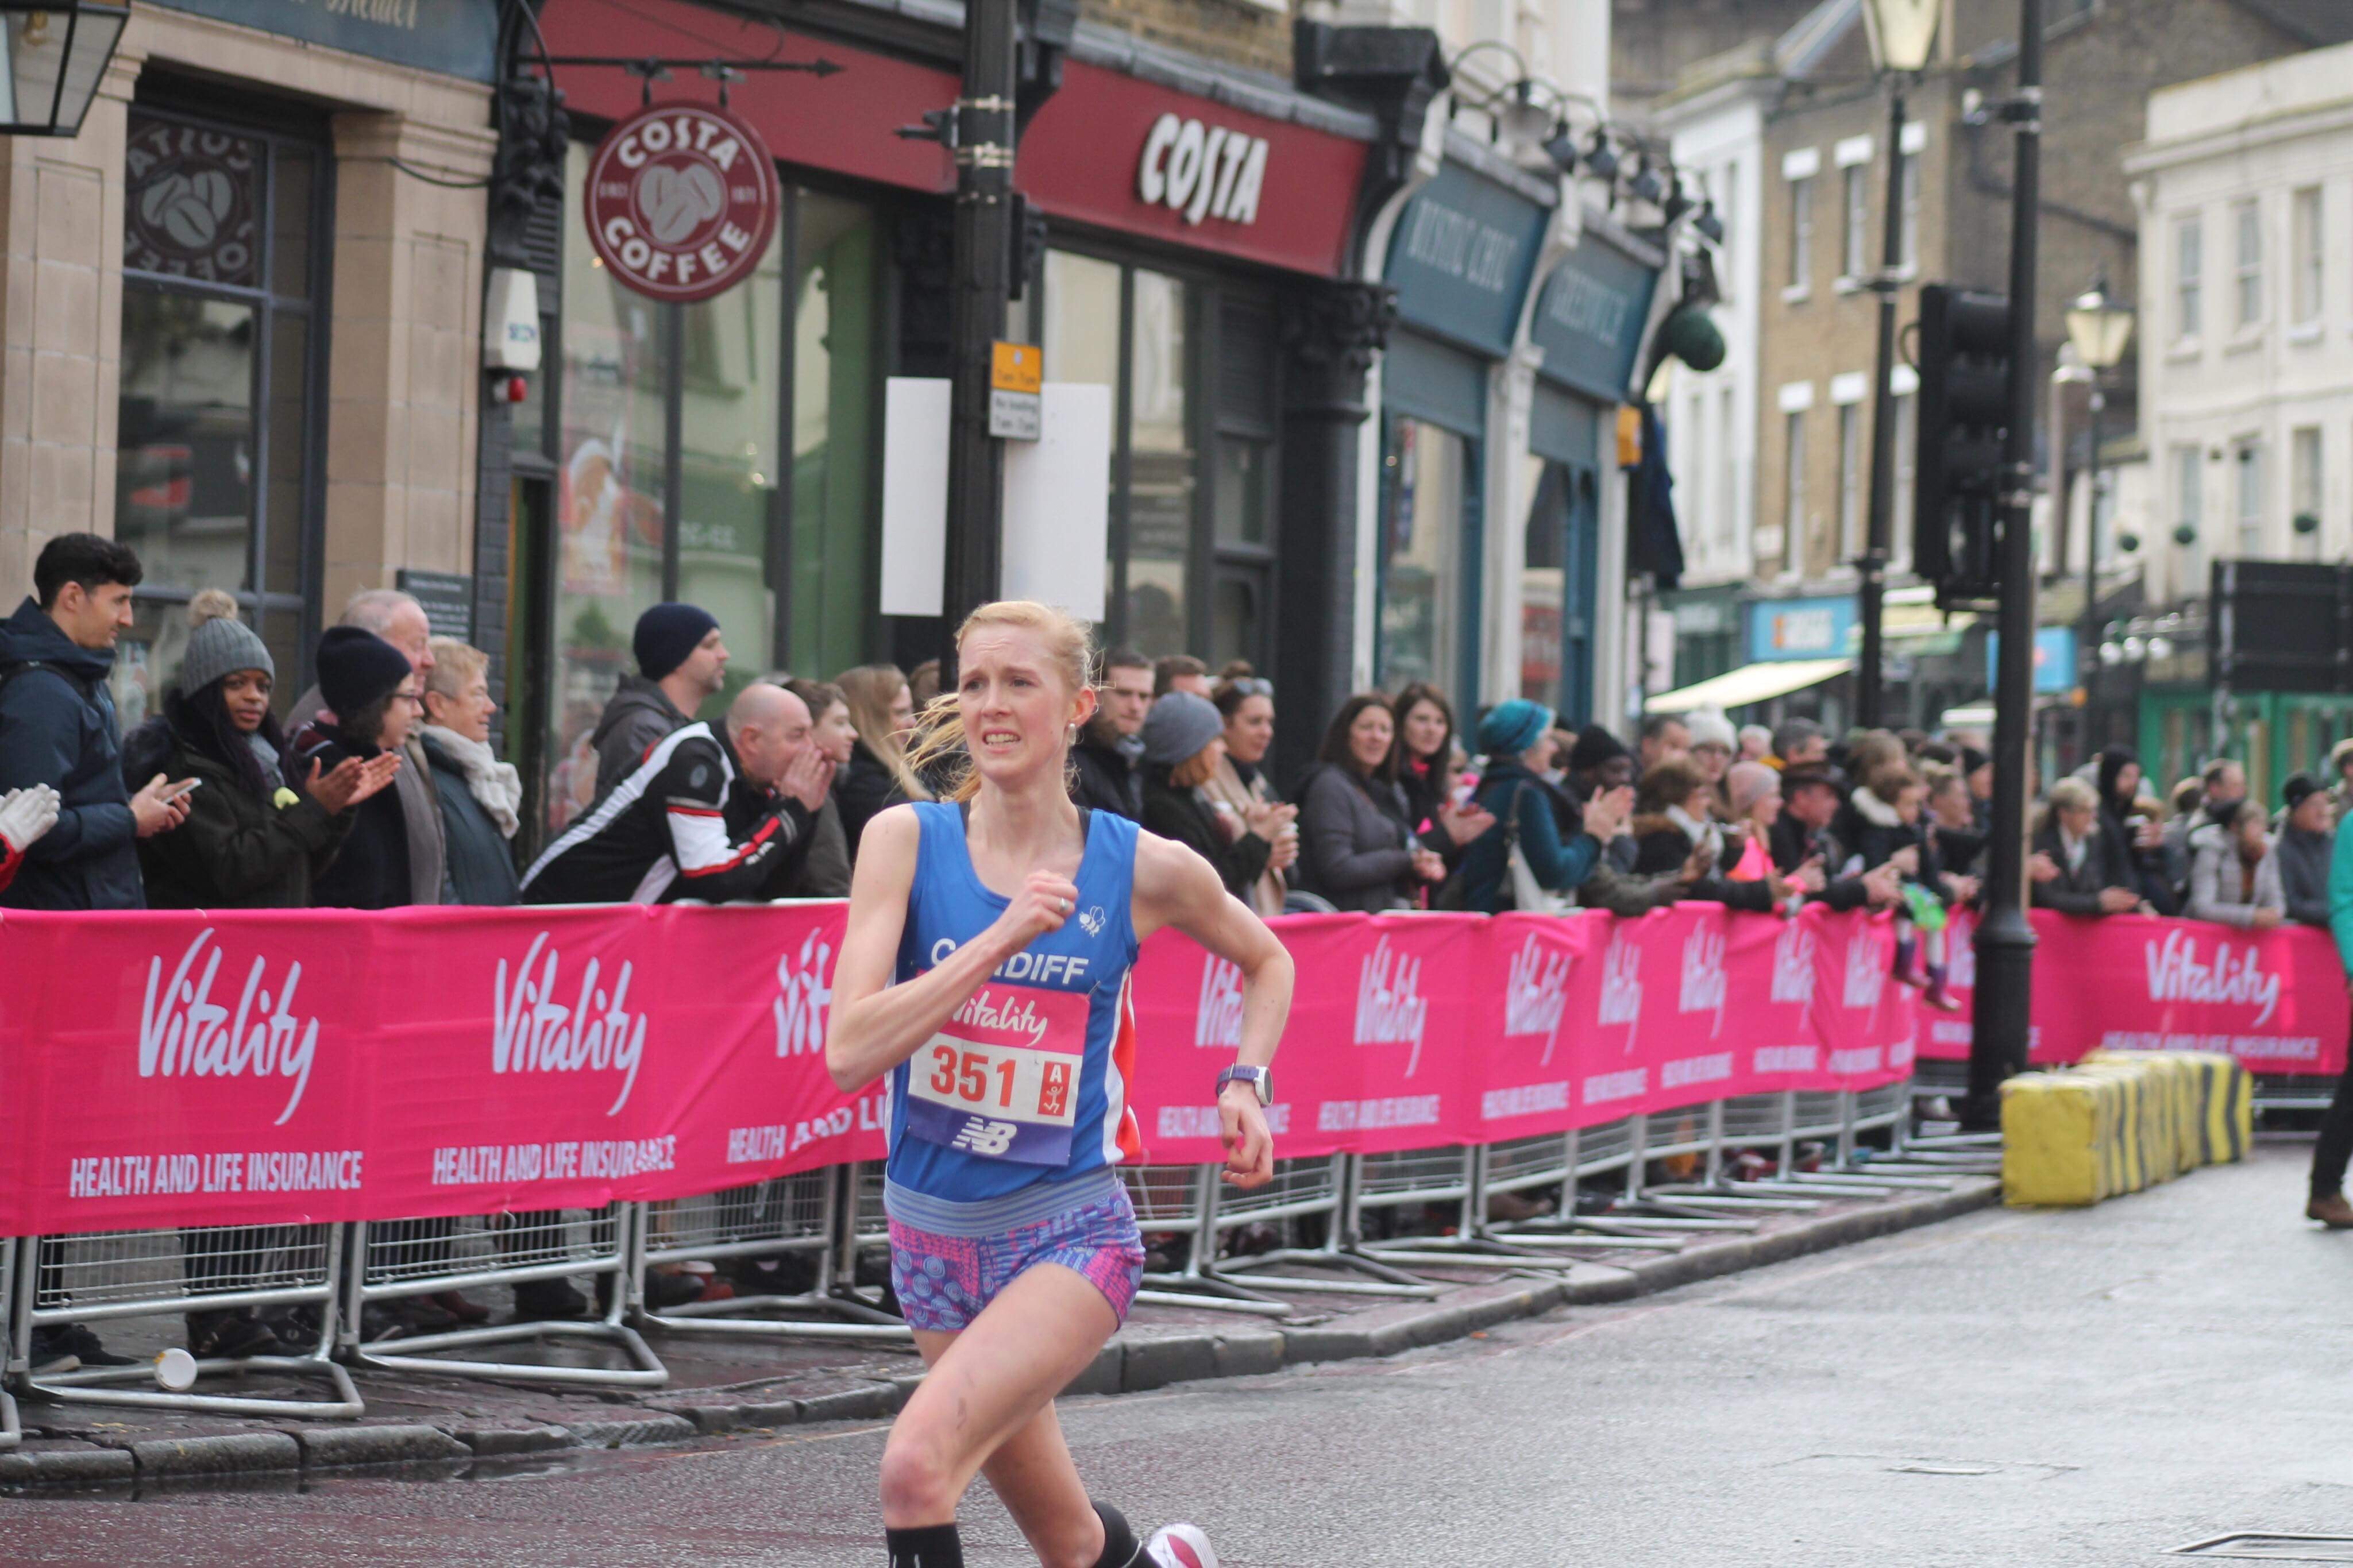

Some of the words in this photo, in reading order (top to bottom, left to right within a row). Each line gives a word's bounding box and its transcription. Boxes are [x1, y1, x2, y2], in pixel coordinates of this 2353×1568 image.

[618, 118, 740, 171] COSTA
[1140, 113, 1269, 225] COSTA
[605, 216, 750, 283] COFFEE
[931, 938, 1089, 984] CDIFF
[2146, 928, 2279, 1028] Vitality
[140, 928, 319, 1125] Vitality
[492, 931, 646, 1116] Vitality
[931, 1045, 1016, 1107] 351
[1050, 1064, 1062, 1083] A
[433, 1146, 502, 1184] HEALTH
[504, 1144, 542, 1181] AND
[544, 1142, 579, 1179] LIFE
[727, 1124, 787, 1164] HEALTH
[789, 1107, 853, 1152] AND
[951, 1116, 1017, 1154] NB
[70, 1155, 151, 1198] HEALTH
[153, 1154, 199, 1194] AND
[202, 1153, 244, 1193] LIFE
[246, 1150, 363, 1192] INSURANCE
